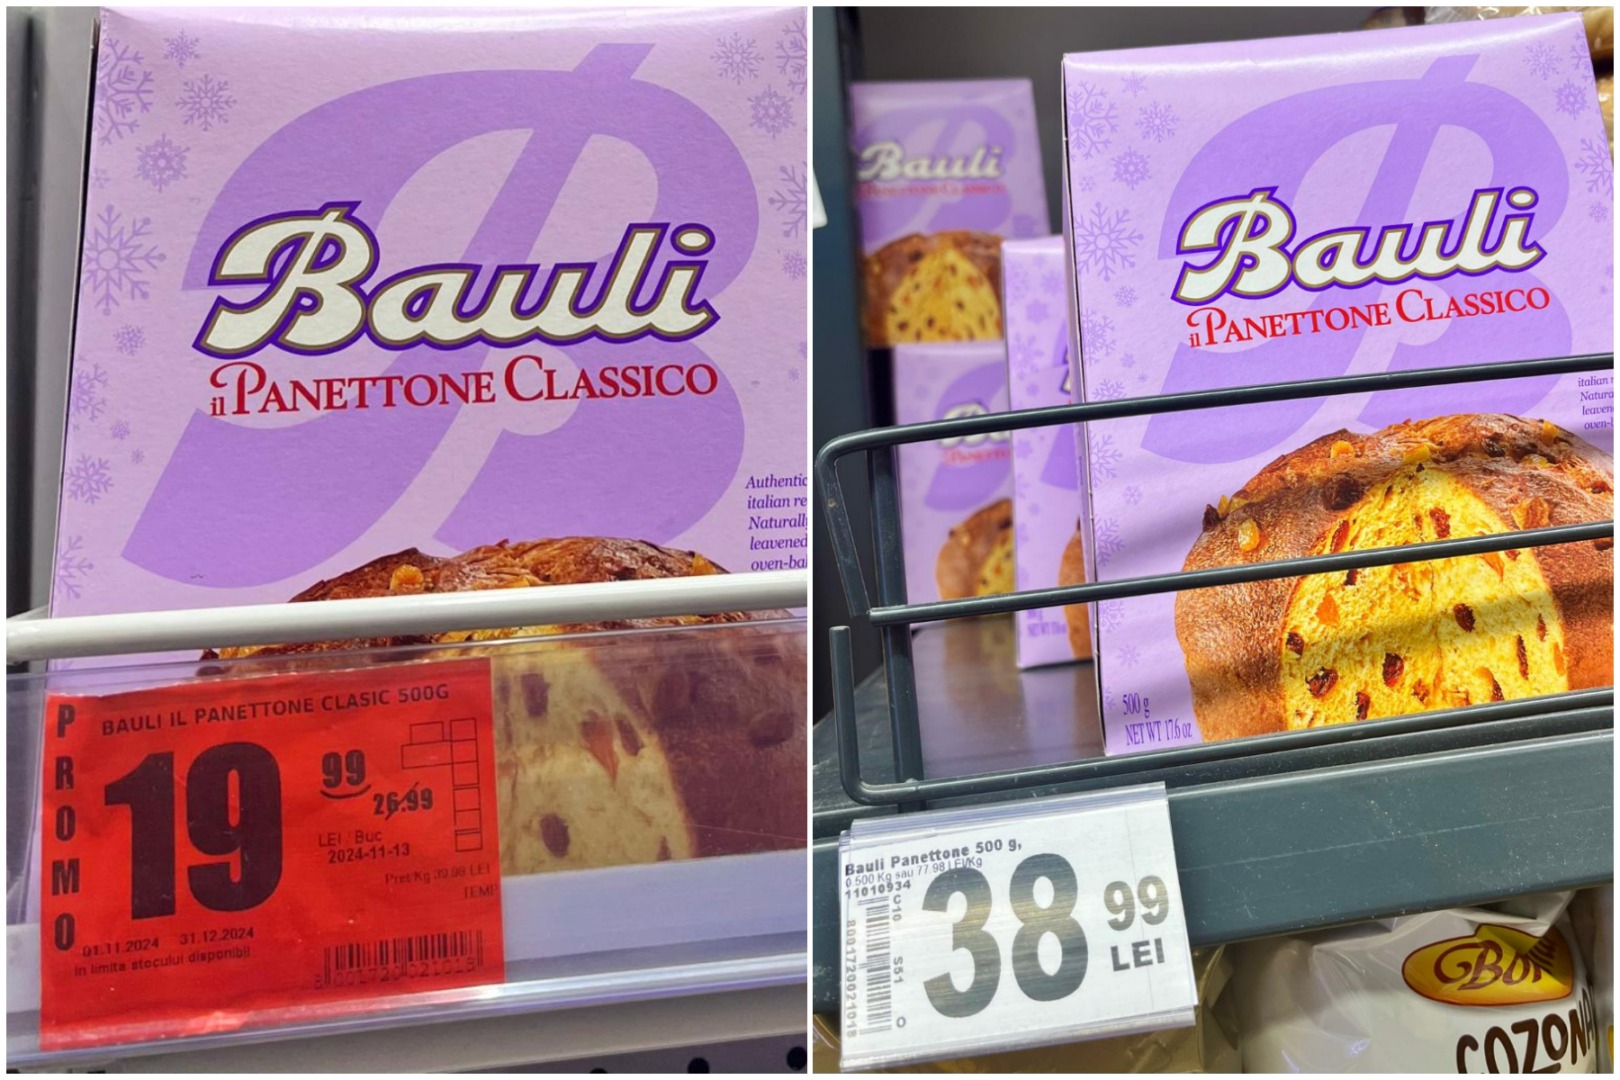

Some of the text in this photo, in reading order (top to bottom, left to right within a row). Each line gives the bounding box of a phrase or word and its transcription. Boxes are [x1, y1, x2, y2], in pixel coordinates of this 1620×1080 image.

[856, 141, 1002, 181] Bauli
[1171, 186, 1547, 306] Bauli
[192, 200, 721, 360] Bauli
[1186, 303, 1391, 346] PANETTONE
[1395, 287, 1550, 323] CLASSICO
[210, 361, 496, 414] PANETTONE
[504, 355, 718, 402] CLASSICO
[1578, 376, 1609, 387] italian
[745, 473, 807, 489] Authentic
[748, 494, 790, 509] italian
[748, 513, 807, 530] Naturall
[751, 554, 807, 571] oven-ba
[102, 683, 450, 737] BAULI IL PANETTONE CLASIC 500G
[1123, 692, 1150, 719] 500 g
[1125, 718, 1193, 746] NET WT 17.6 oz
[373, 787, 434, 815] 26.99
[104, 741, 366, 921] 19 99
[318, 832, 342, 848] LEI
[328, 843, 411, 864] 2024-11-13
[845, 839, 1023, 877] Bauli Panettone 500 g,
[469, 863, 491, 876] LEI
[846, 873, 875, 889] 0.500
[877, 870, 892, 884] Kg
[895, 867, 914, 880] sau
[917, 862, 945, 876] 77.98
[845, 879, 912, 900] 11010934
[82, 927, 255, 958] 01.11.2024 31.12.2024
[922, 853, 1170, 1018] 38 99
[91, 960, 127, 975] limita
[131, 952, 184, 971] stocului
[188, 946, 251, 965] disponibil
[1110, 937, 1166, 972] LEI
